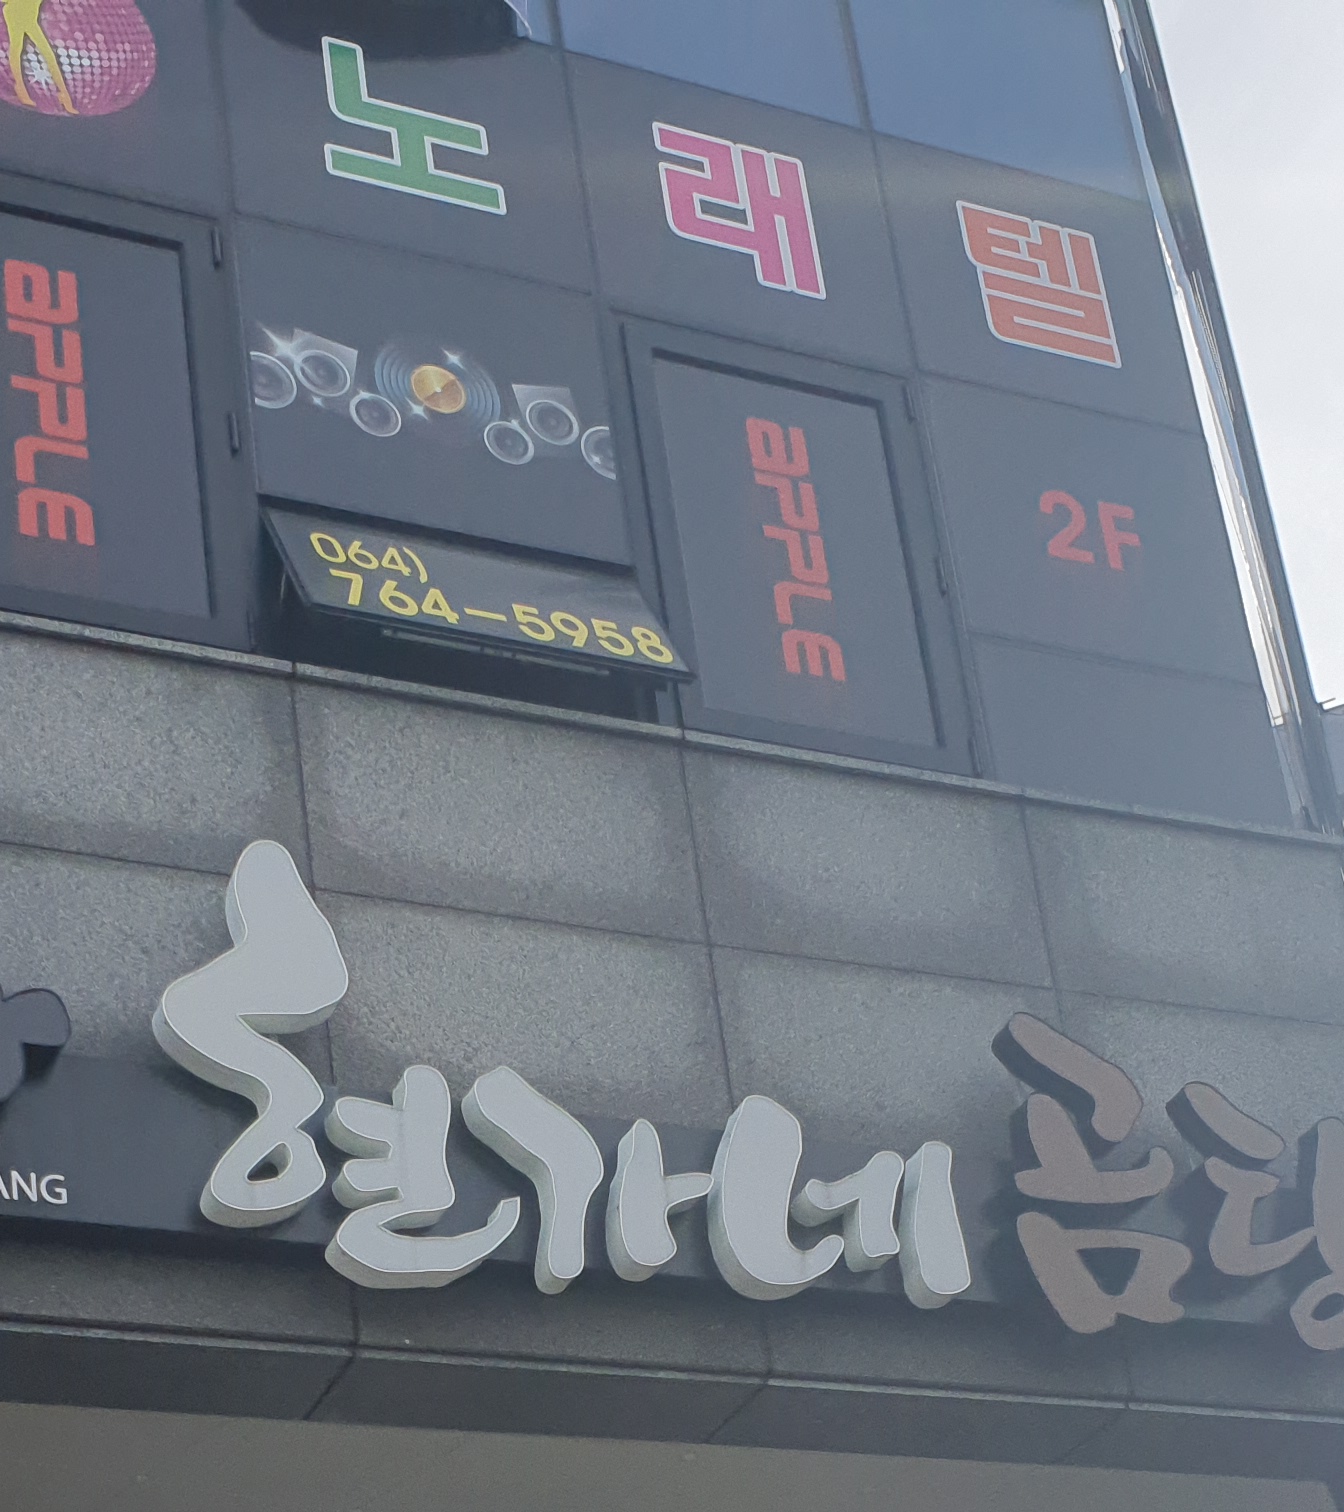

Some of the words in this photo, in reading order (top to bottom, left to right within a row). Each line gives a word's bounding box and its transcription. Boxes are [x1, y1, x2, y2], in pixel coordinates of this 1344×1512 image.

[1038, 490, 1141, 571] 2F
[327, 569, 674, 665] 764-5958
[156, 840, 970, 1300] 현가네
